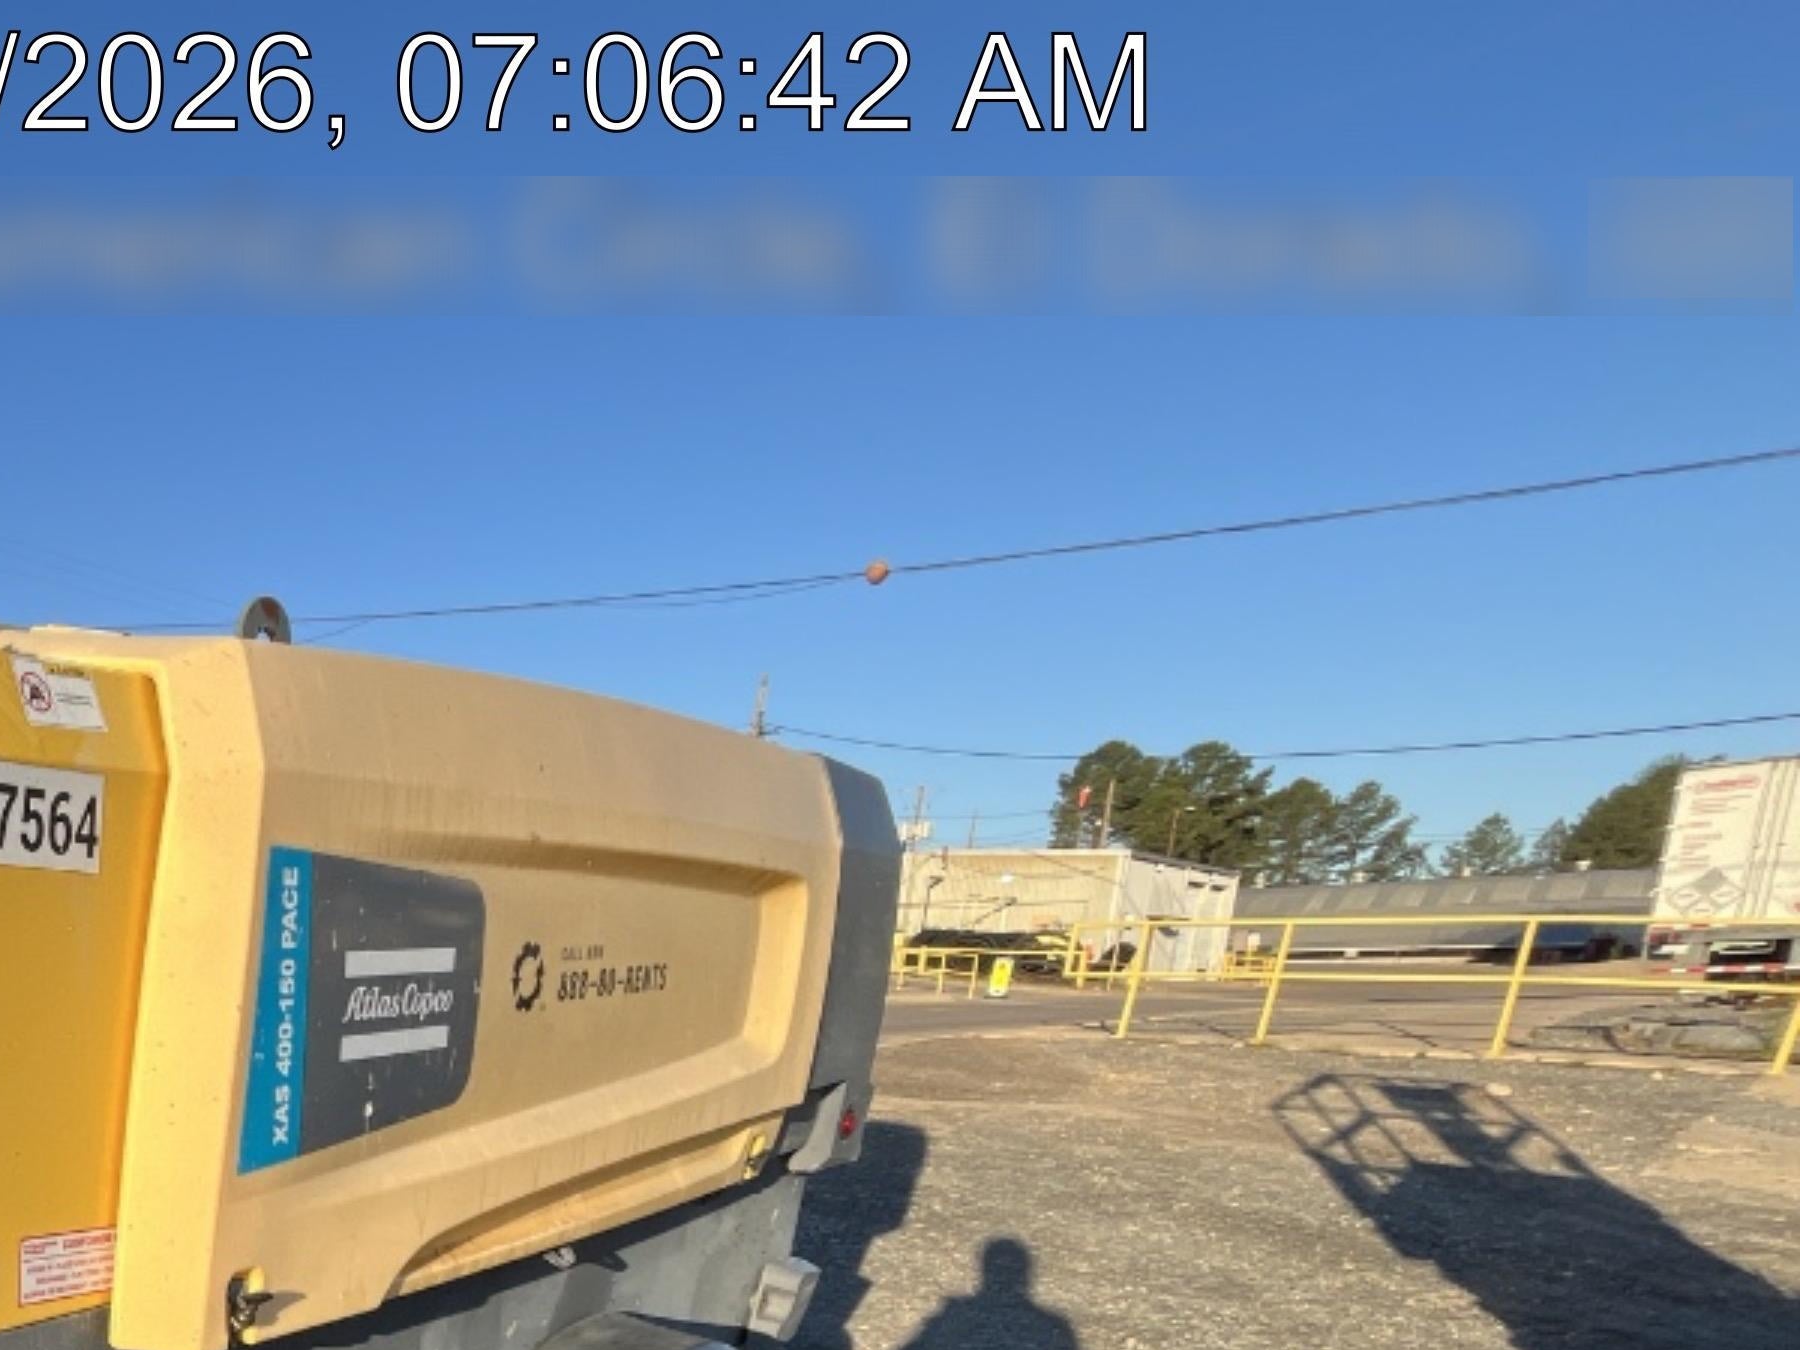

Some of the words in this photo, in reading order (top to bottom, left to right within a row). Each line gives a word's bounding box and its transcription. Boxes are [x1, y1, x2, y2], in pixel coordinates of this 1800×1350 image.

[281, 866, 300, 949] PACE
[276, 959, 296, 1077] 400-150
[341, 986, 400, 1024] Atlas
[401, 983, 455, 1022] Copco
[273, 1084, 291, 1146] XAS
